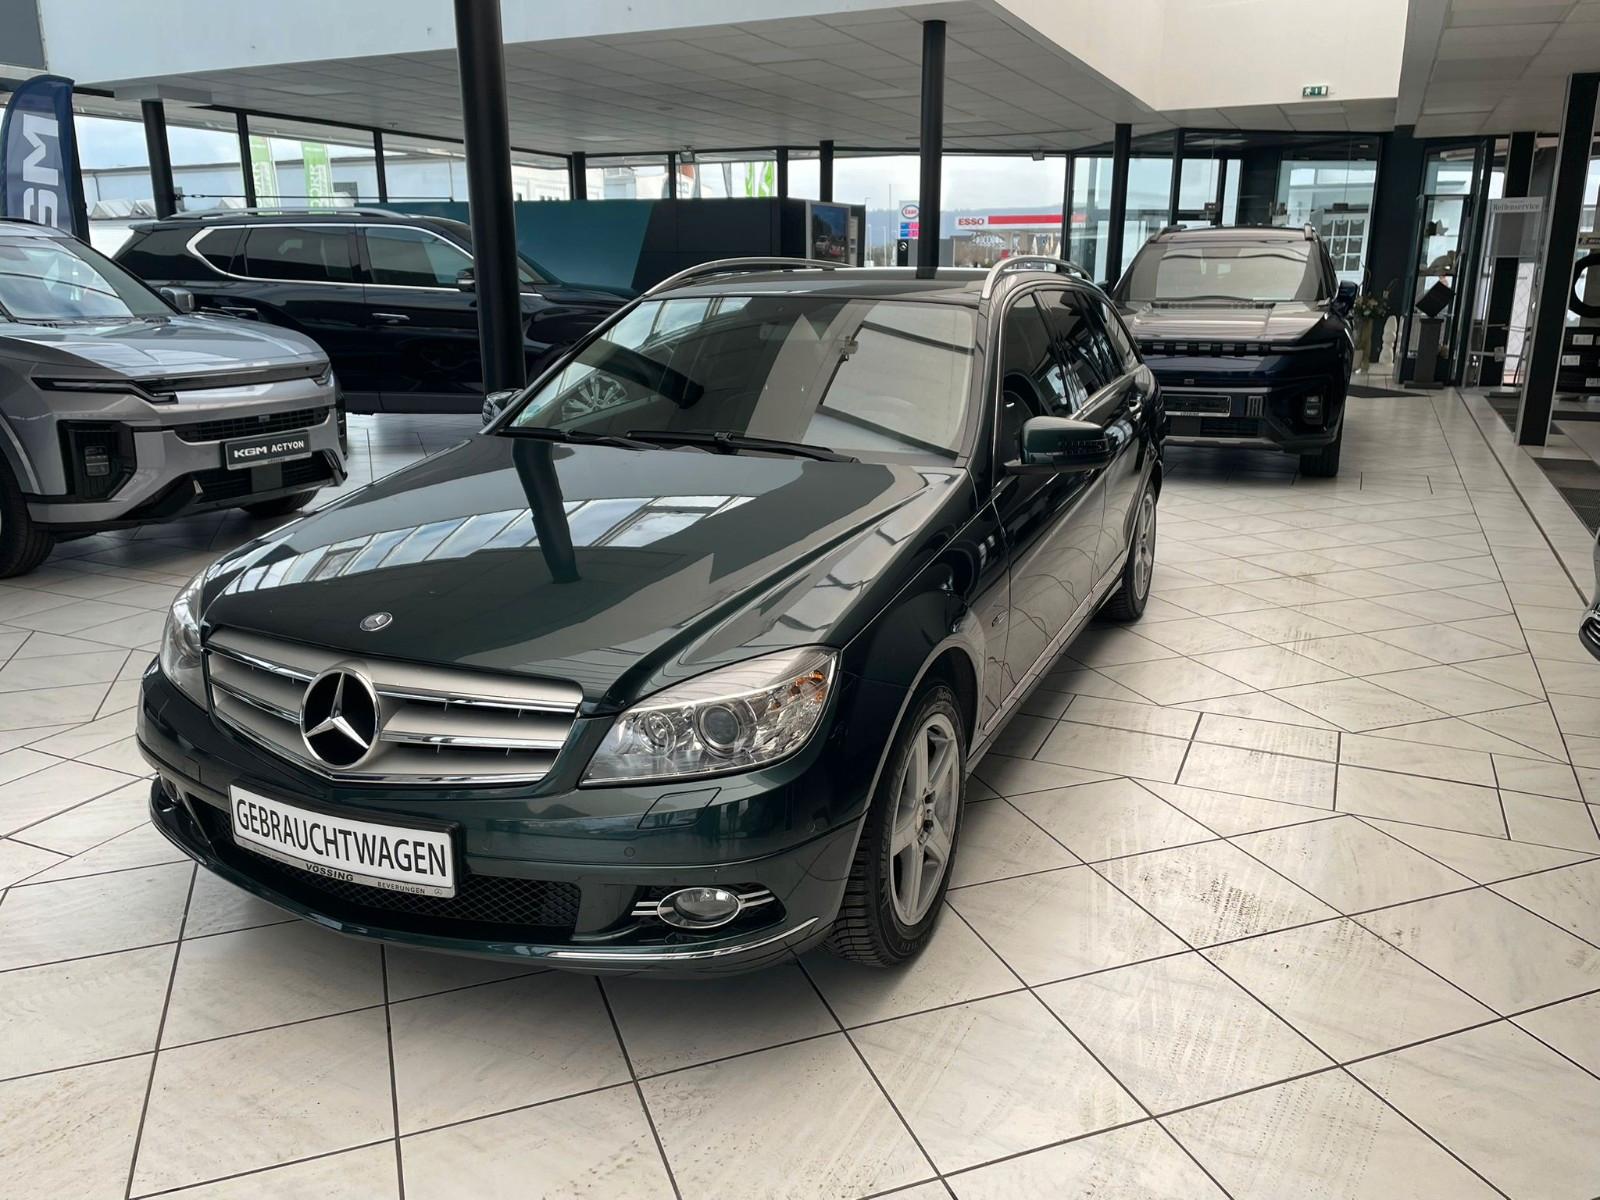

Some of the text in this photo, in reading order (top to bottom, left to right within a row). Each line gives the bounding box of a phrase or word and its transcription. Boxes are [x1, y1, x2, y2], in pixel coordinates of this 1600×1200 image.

[958, 218, 985, 226] ESSO
[234, 440, 304, 458] KGM ACTYON
[237, 799, 447, 877] GEBRAUCHTWAGEN
[377, 881, 425, 894] BEVERUNGEN
